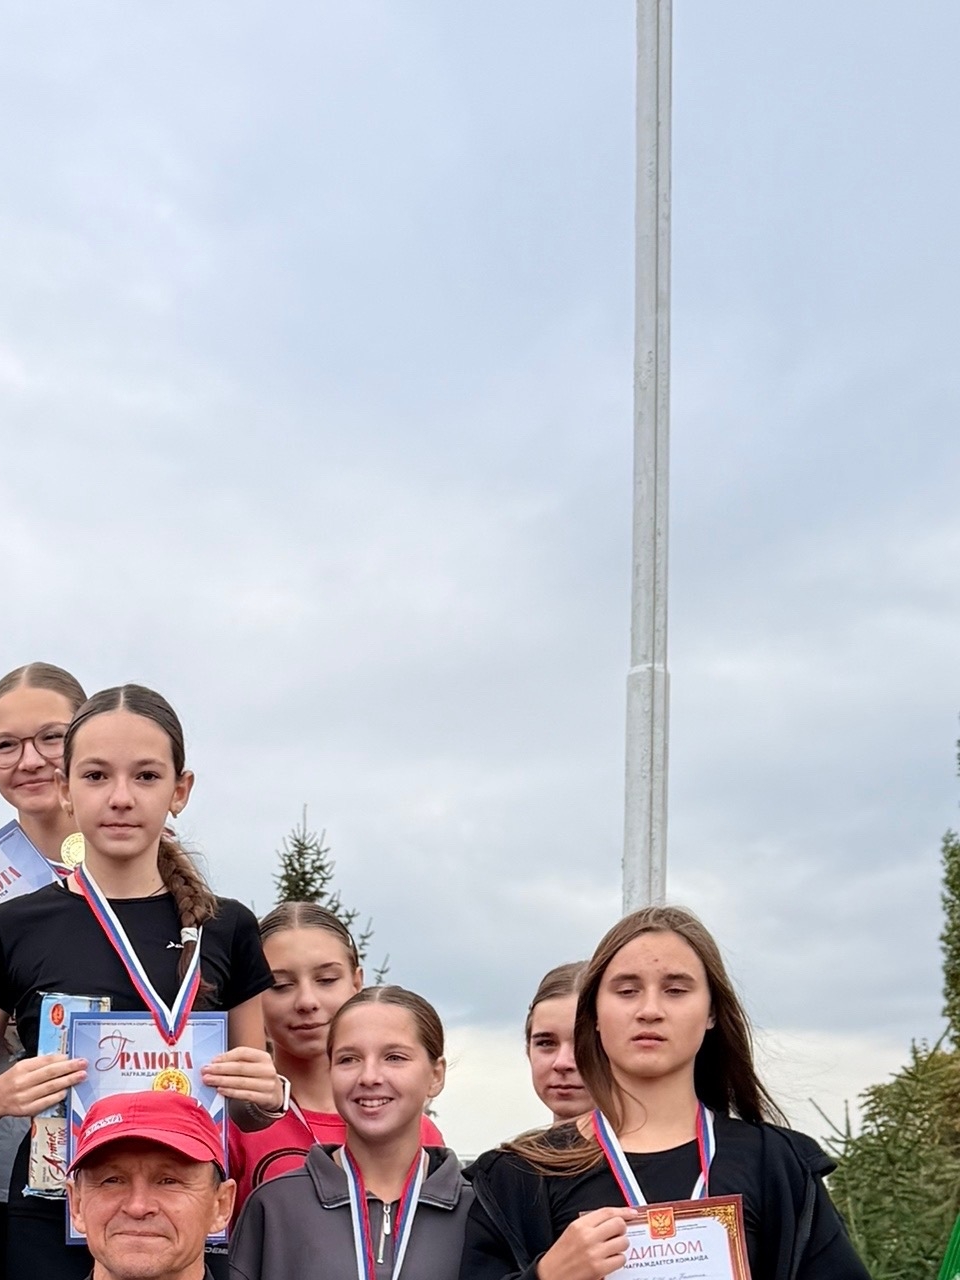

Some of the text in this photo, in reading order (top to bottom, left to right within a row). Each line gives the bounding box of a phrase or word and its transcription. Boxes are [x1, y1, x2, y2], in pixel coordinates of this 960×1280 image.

[628, 1240, 703, 1261] ДИПЛОМ
[624, 1255, 709, 1269] НАГРАЖДАЕТСЯ КОМАНДА
